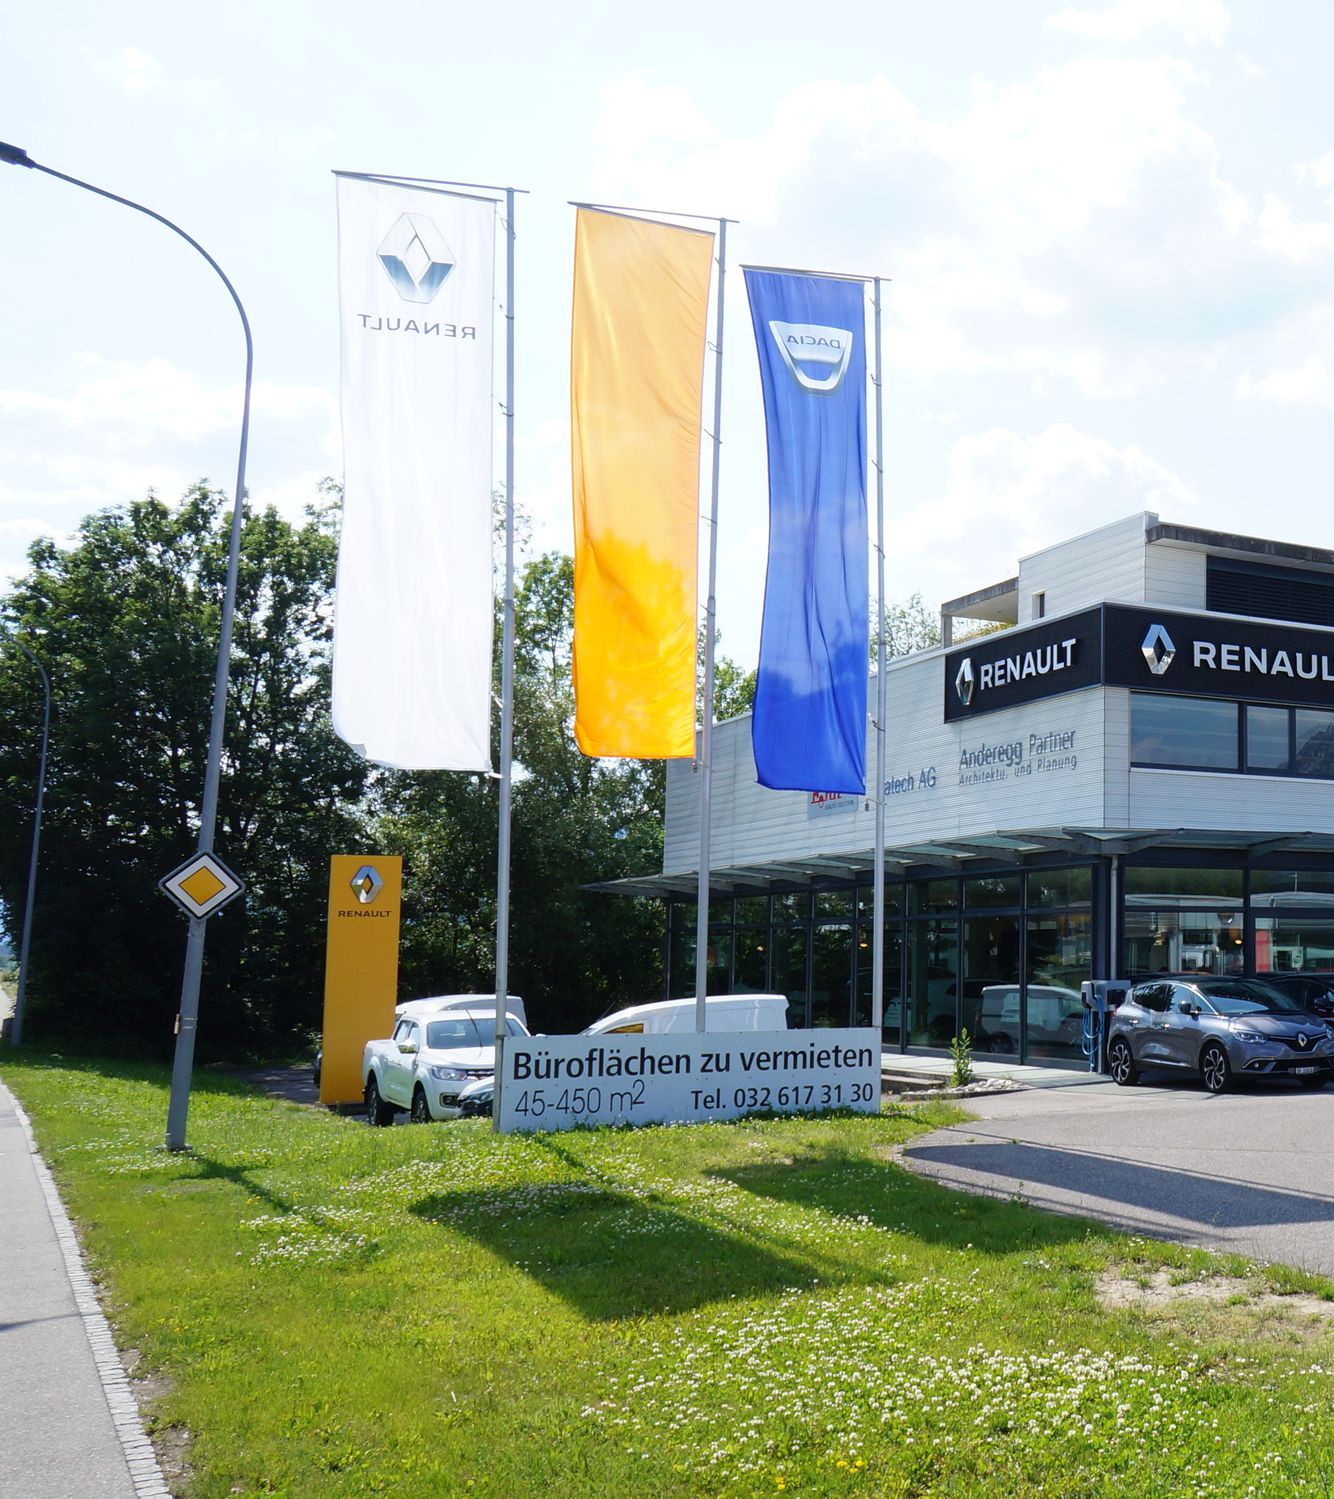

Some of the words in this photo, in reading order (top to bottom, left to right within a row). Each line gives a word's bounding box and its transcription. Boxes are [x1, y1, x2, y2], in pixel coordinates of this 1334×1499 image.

[980, 638, 1077, 690] RENAULT
[959, 742, 1023, 770] Anderegg
[1029, 730, 1076, 756] Partner
[1014, 760, 1032, 777] und
[1037, 755, 1077, 772] Planung
[884, 771, 915, 795] atech
[918, 766, 937, 789] AG
[338, 910, 392, 918] RENAULT
[513, 1048, 691, 1080] Büroflächen
[700, 1052, 730, 1073] zu
[740, 1043, 873, 1072] vermieten
[515, 1087, 601, 1117] 45-450
[691, 1088, 726, 1110] Tel.
[734, 1087, 770, 1109] 032
[778, 1085, 814, 1106] 617
[821, 1084, 843, 1104] 31
[850, 1082, 874, 1102] 30
